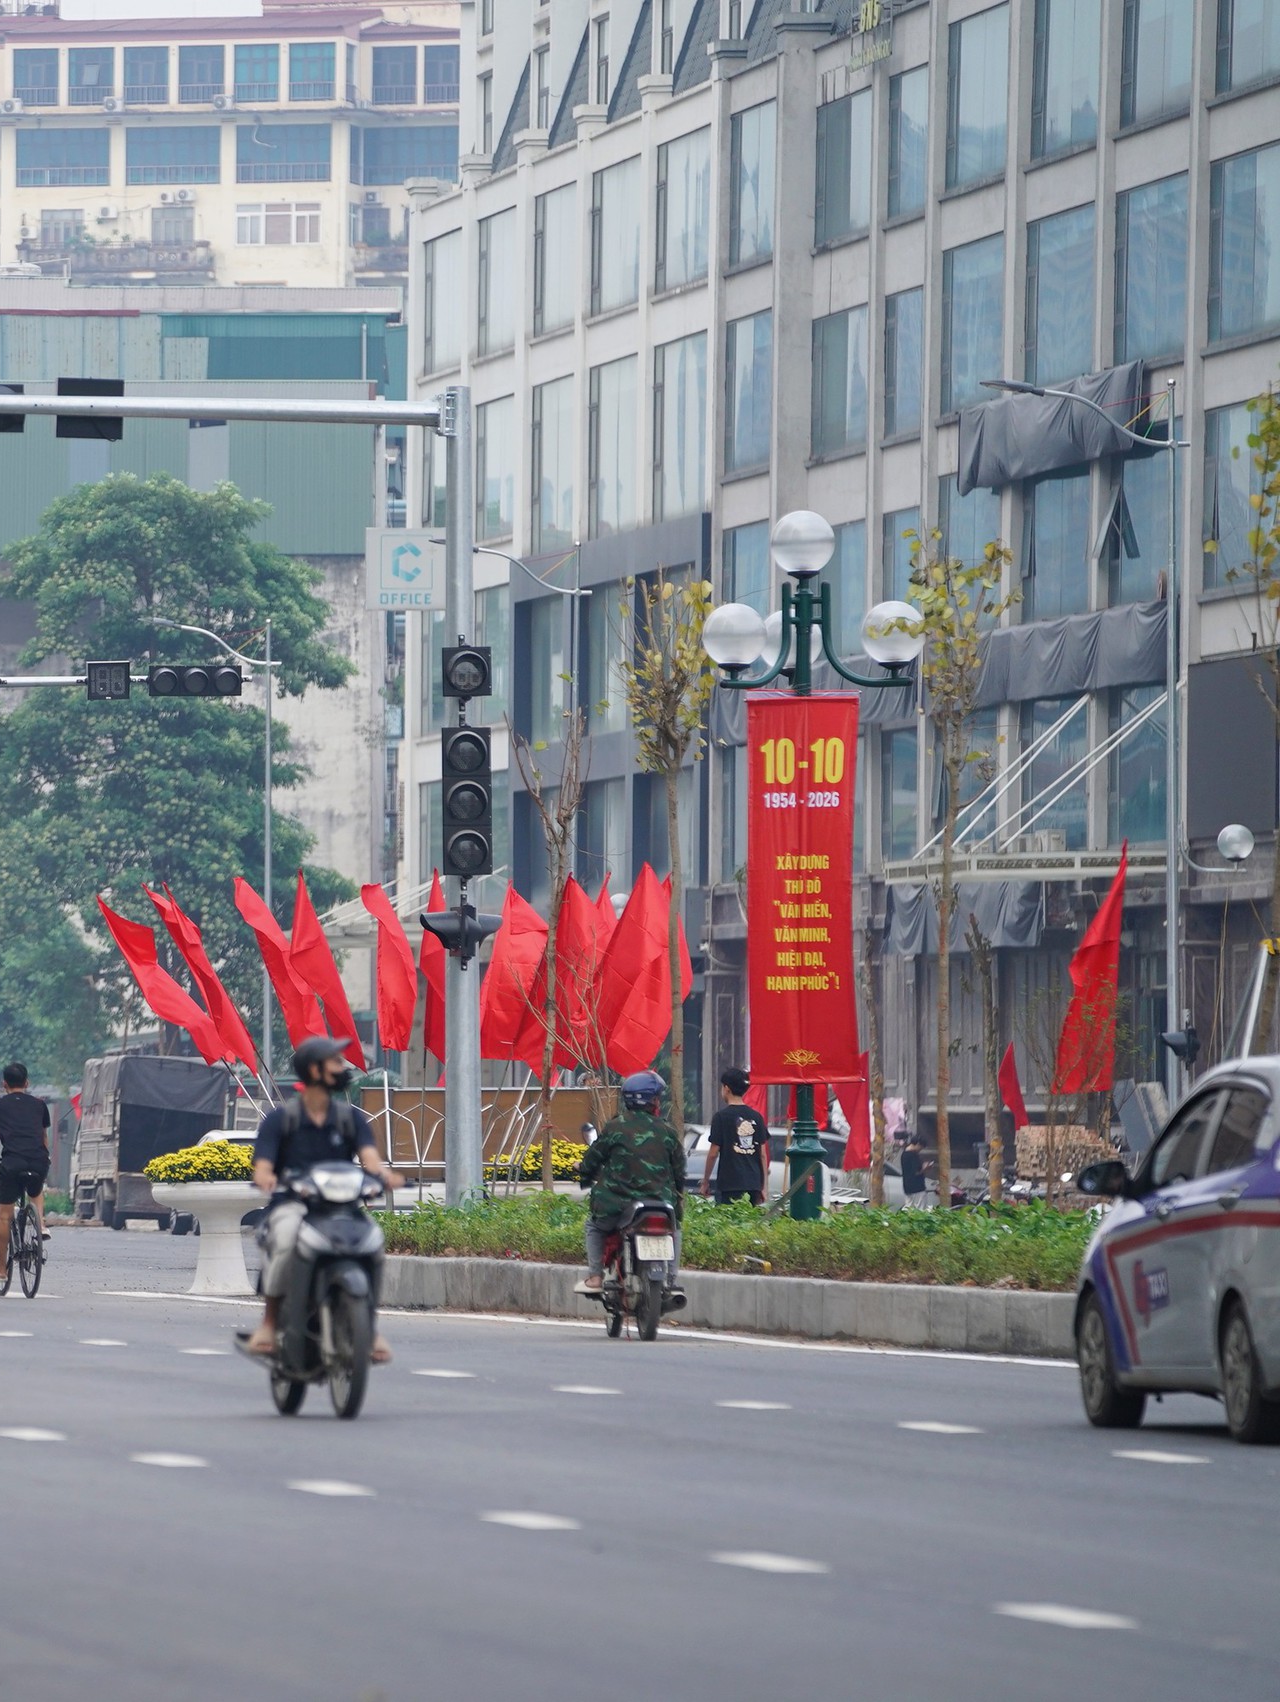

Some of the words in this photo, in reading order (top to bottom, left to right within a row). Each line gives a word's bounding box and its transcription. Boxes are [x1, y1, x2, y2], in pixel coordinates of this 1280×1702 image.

[380, 593, 432, 605] OFFICE
[764, 792, 796, 809] 1954
[808, 791, 840, 808] 2026
[776, 853, 799, 870] XÂY
[800, 854, 830, 873] DỰNG
[785, 875, 804, 894] THỦ
[806, 876, 822, 894] ĐÔ
[803, 899, 832, 920] HIẾN,
[775, 925, 798, 942] VĂN
[799, 927, 831, 943] MINH,
[777, 949, 802, 970] HIỆN
[804, 951, 827, 970] ĐẠI,
[767, 976, 799, 994] HẠNH
[1147, 1270, 1169, 1299] TAXI
